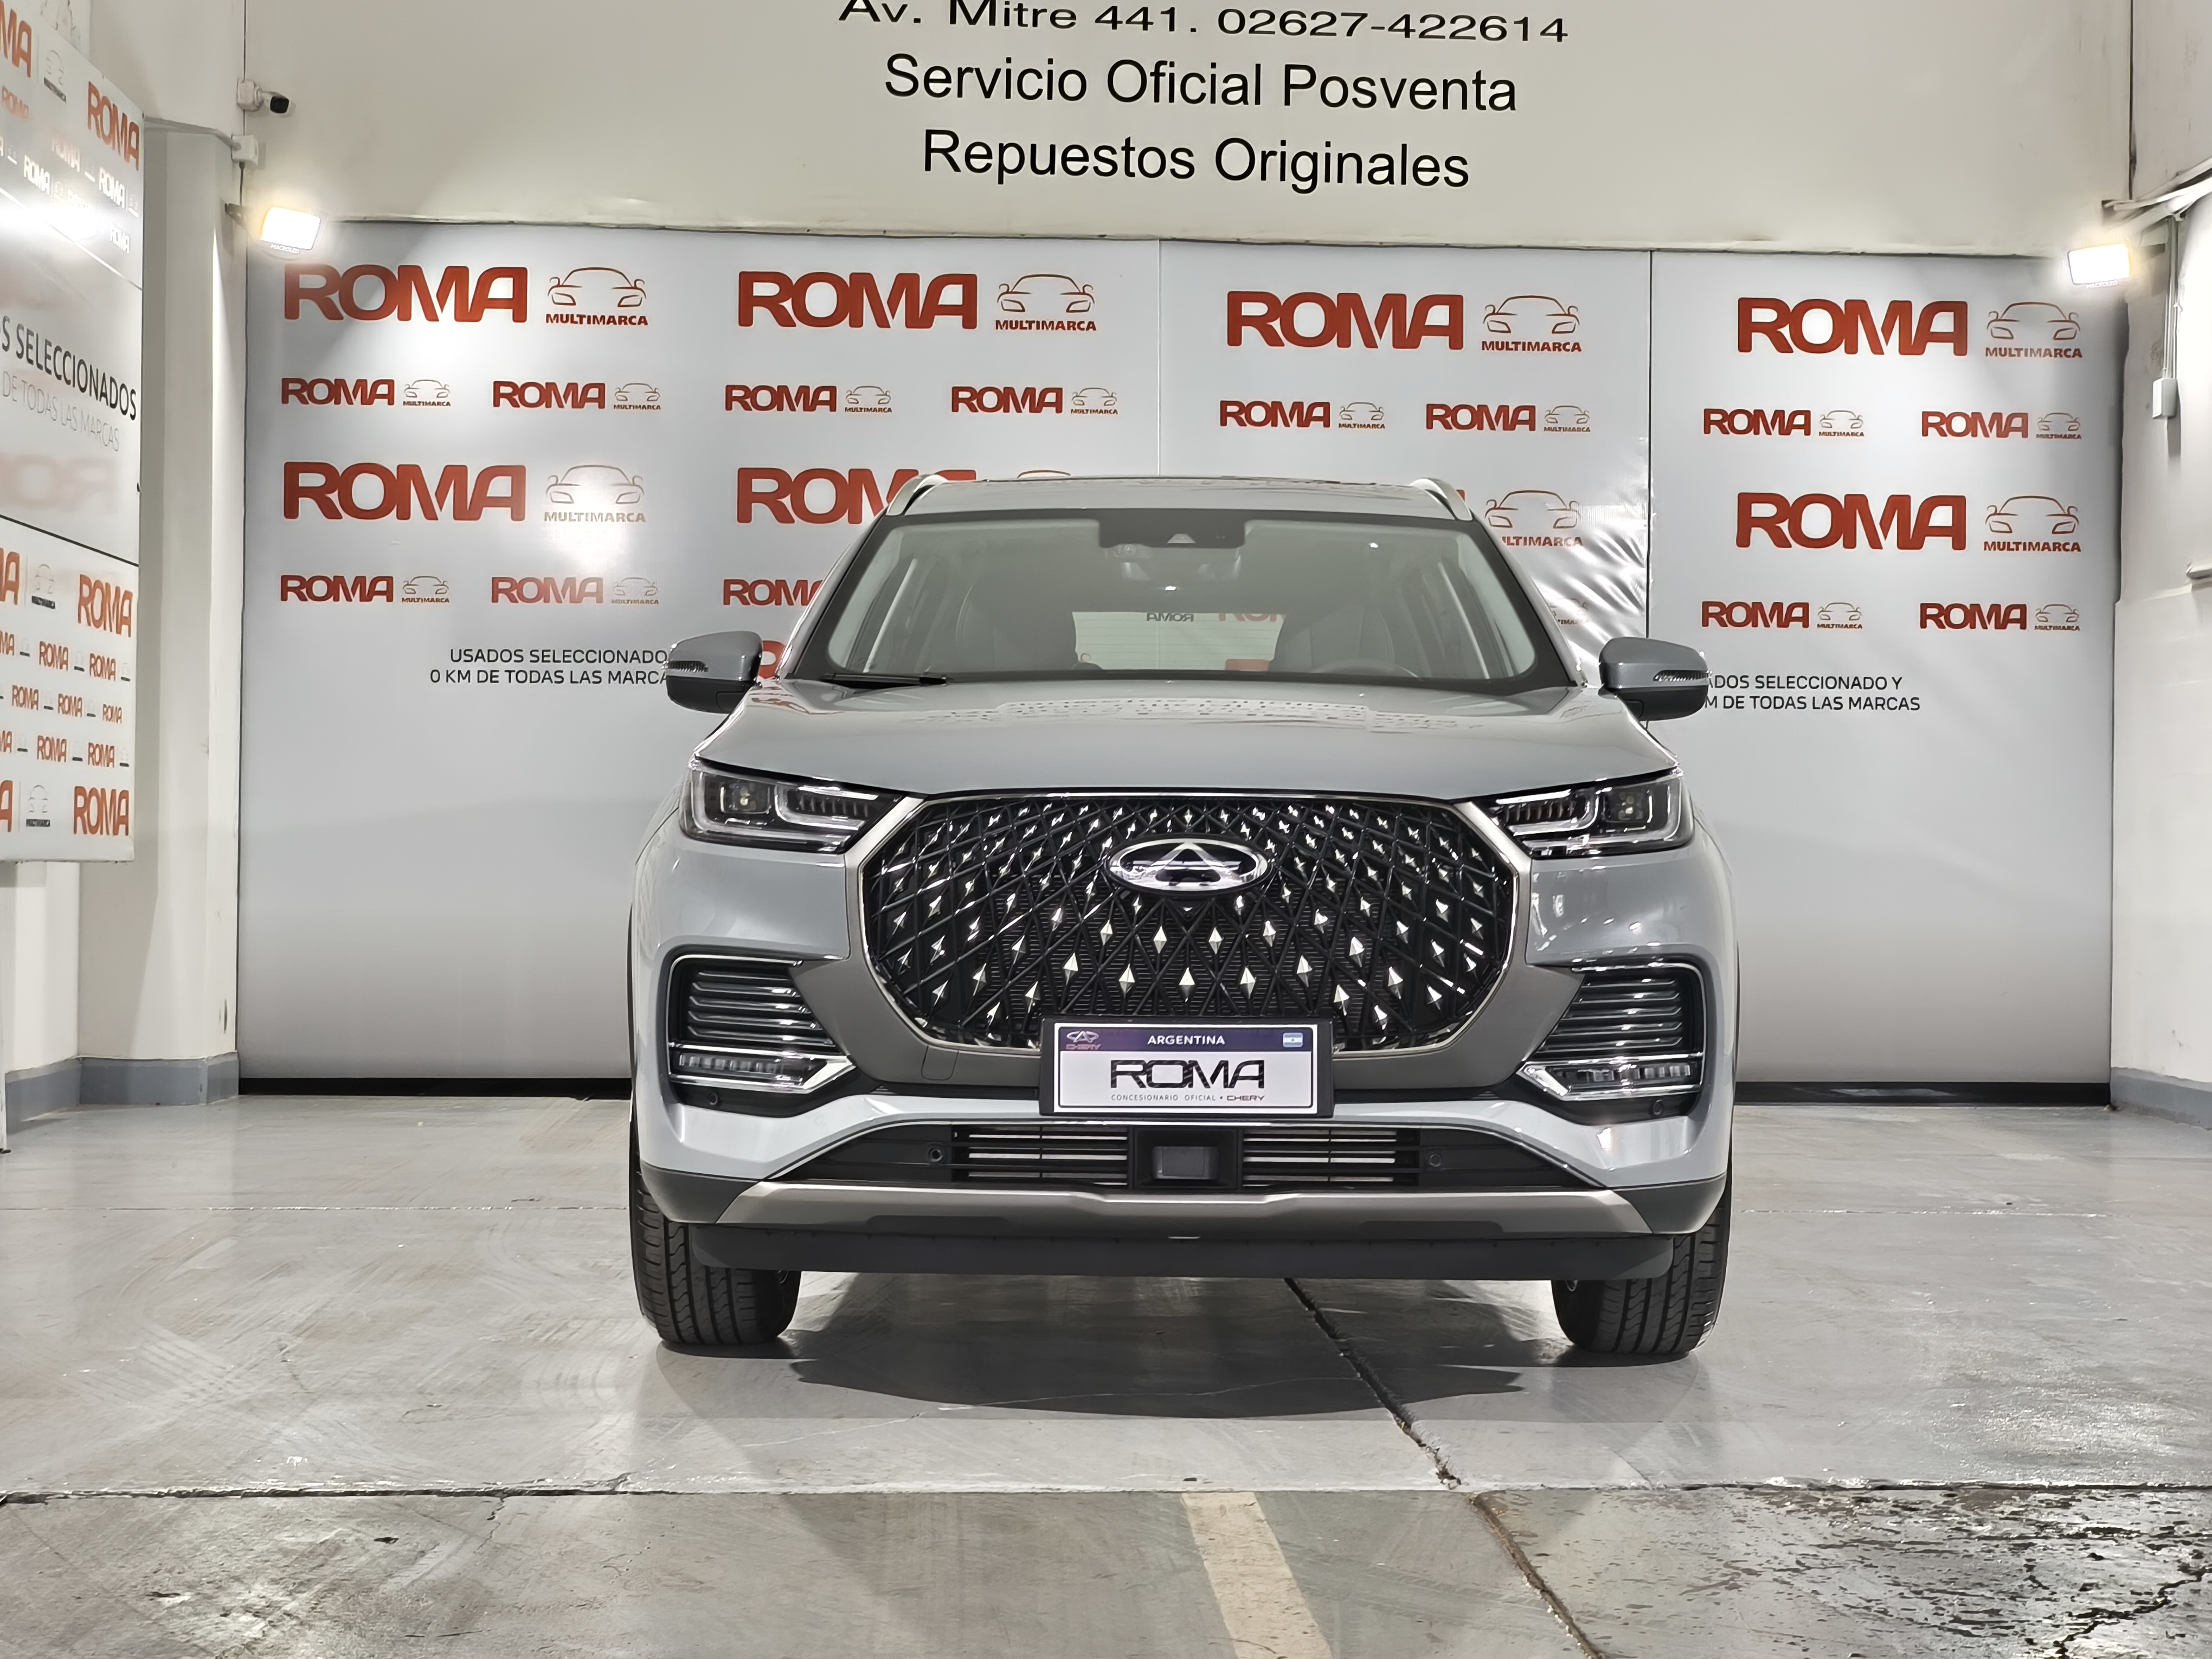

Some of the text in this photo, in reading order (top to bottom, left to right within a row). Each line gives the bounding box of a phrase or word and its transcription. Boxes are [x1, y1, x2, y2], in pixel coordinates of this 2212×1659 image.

[839, 0, 1568, 42] Av. Mitre 441. 02627-422614
[0, 0, 31, 78] MA
[886, 54, 1516, 111] Servicio Oficial Posventa
[88, 81, 139, 171] ROMA
[24, 155, 50, 196] ROMA
[925, 130, 1468, 194] Repuestos Originales
[99, 165, 125, 209] ROMA
[110, 223, 130, 254] ROMA
[284, 263, 648, 325] ROMA MULTIMARCA
[738, 271, 1096, 331] ROMA MULTIMARCA
[1227, 291, 1581, 352] ROMA MULTIMARCA
[1738, 297, 2082, 358] ROMA MULTIMARCA
[16, 323, 136, 420] SELECCIONADOS
[281, 377, 395, 407] ROMA
[493, 381, 605, 409] ROMA
[725, 385, 837, 412] ROMA
[951, 387, 1063, 414] ROMA
[3, 371, 120, 452] DE TODAS LAS MARCAS
[1220, 400, 1330, 428] ROMA
[1426, 403, 1535, 431] ROMA
[1703, 408, 1811, 436] ROMA
[1922, 411, 2028, 438] ROMA
[284, 461, 646, 523] ROMA MULTIMARCA
[737, 467, 976, 524] ROM
[1736, 492, 2081, 552] ROMA MULTIMARCA
[1502, 536, 1584, 546] LTIMARCA
[281, 575, 394, 602] ROMA
[492, 576, 603, 604] ROMA
[78, 574, 133, 638] ROMA
[1702, 601, 1809, 628] ROMA
[1920, 603, 2027, 630] ROMA
[0, 630, 116, 681] MA ROMA ROMA
[451, 649, 667, 664] USADOS SELECCIONADO
[430, 670, 667, 684] 0 KM DE TODAS LAS MARCA
[1709, 675, 1902, 690] DOS SELECCIONADO Y
[12, 685, 123, 724] ROMA ROMA ROMA
[1705, 696, 1920, 710] M DE TODAS LAS MARCAS
[36, 735, 67, 762] ROMA
[88, 742, 115, 768] ROMA
[74, 786, 129, 836] ROMA
[1148, 1036, 1225, 1044] ARGENTINA
[1111, 1060, 1264, 1089] ROMA
